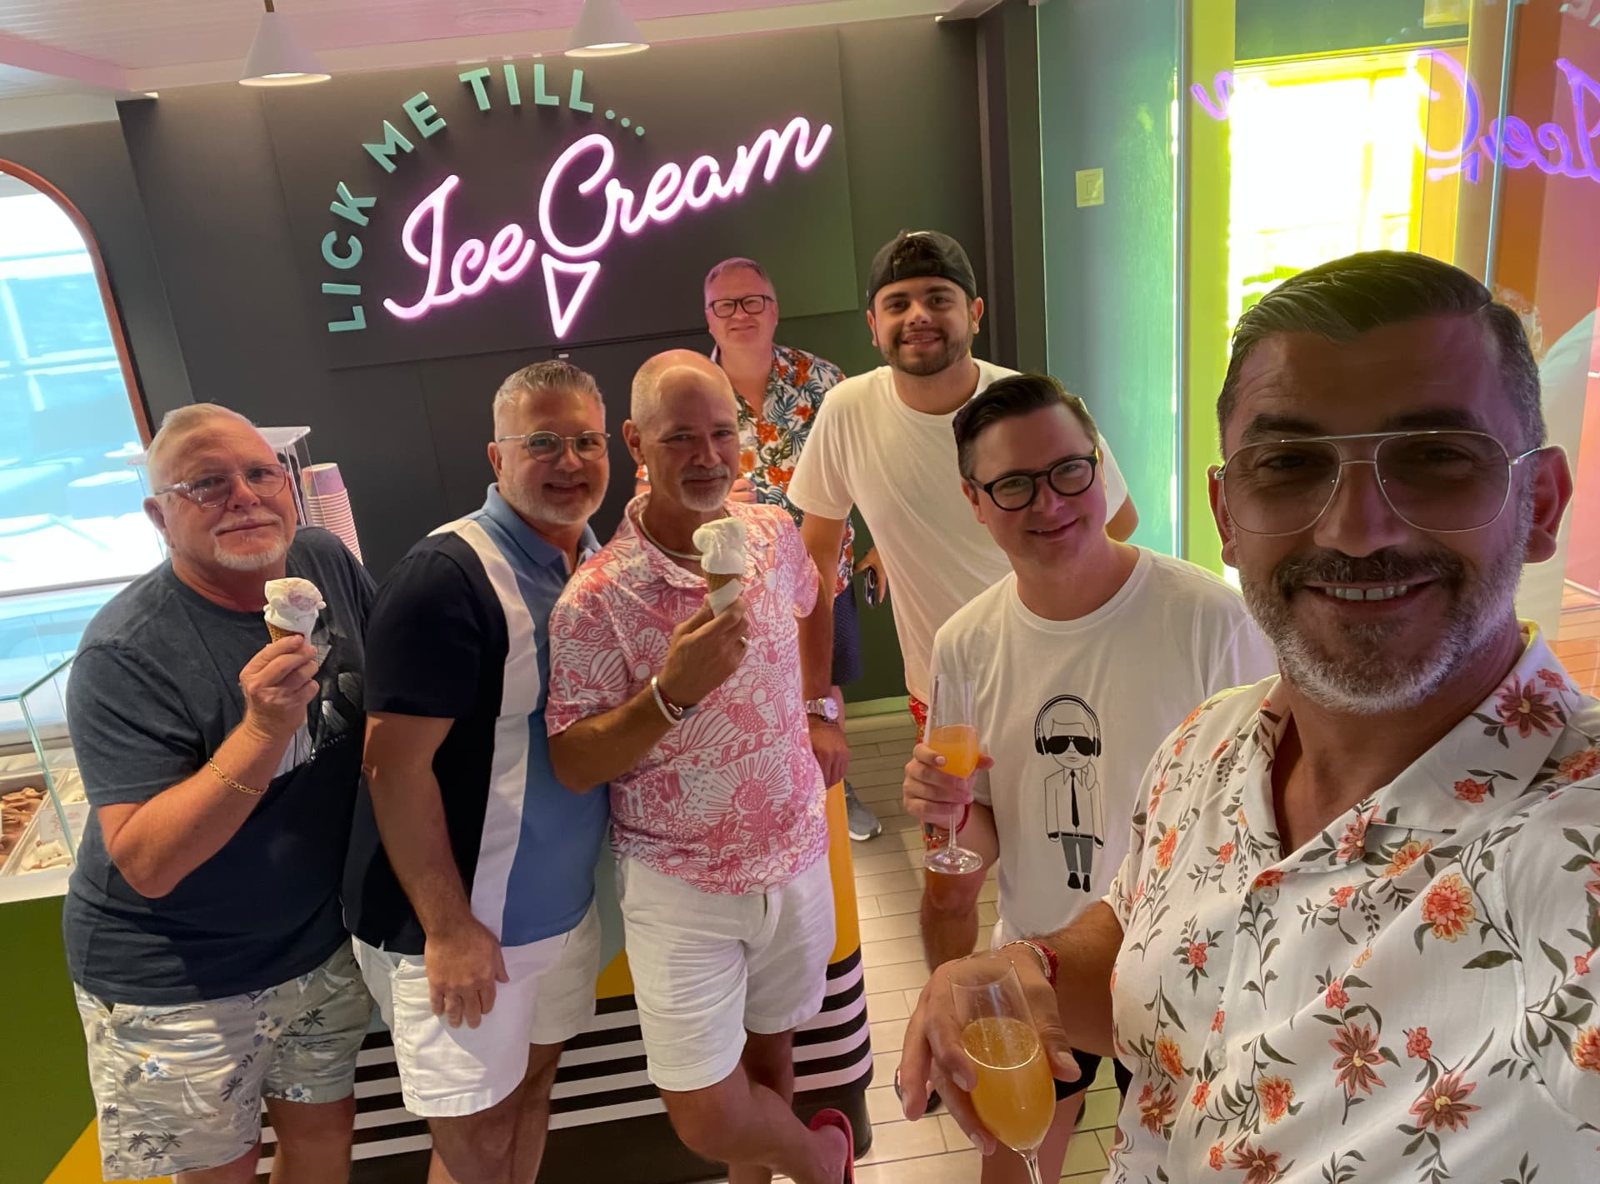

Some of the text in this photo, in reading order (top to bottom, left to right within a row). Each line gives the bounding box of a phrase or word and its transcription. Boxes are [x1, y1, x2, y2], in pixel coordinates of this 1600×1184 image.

[321, 64, 646, 333] LICK ME TILL...
[383, 116, 833, 320] Ice Cream
